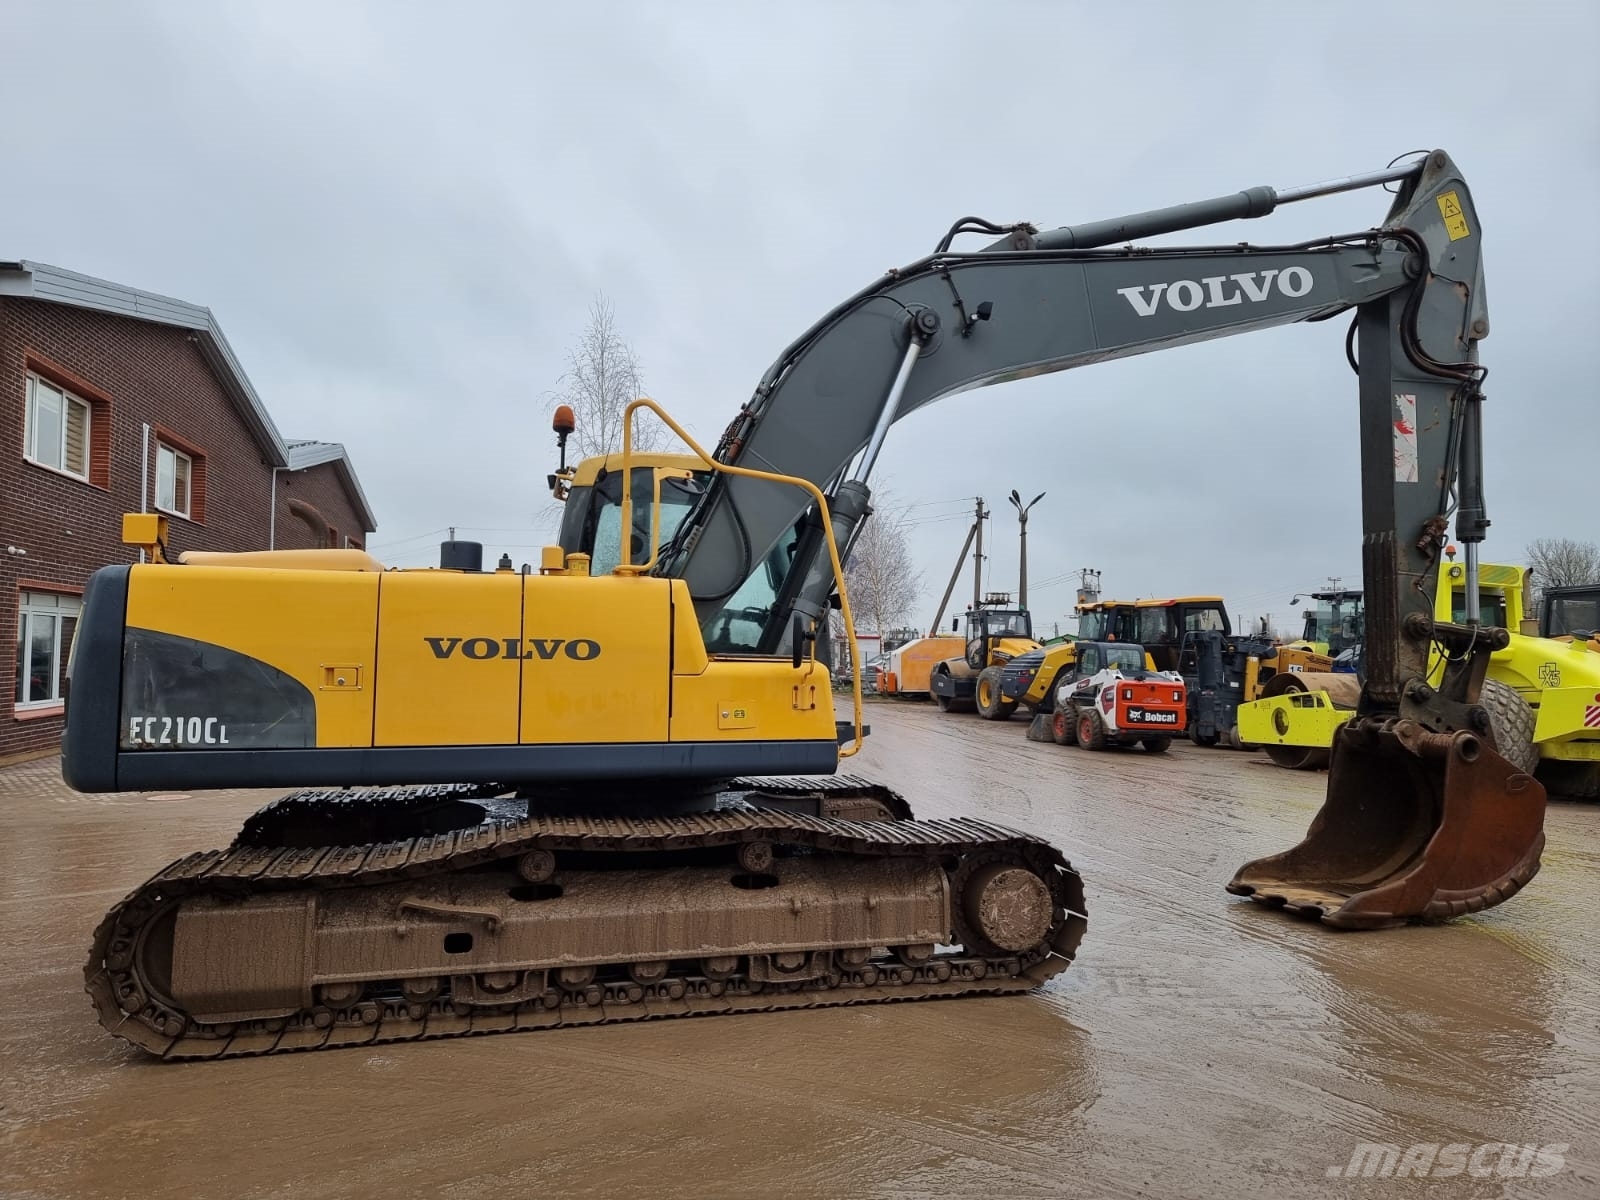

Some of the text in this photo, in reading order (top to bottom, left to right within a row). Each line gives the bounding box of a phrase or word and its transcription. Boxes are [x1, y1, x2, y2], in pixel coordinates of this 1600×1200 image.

[1117, 266, 1314, 317] VOLVO
[423, 637, 602, 661] VOLVO
[1144, 712, 1176, 723] Bobcat
